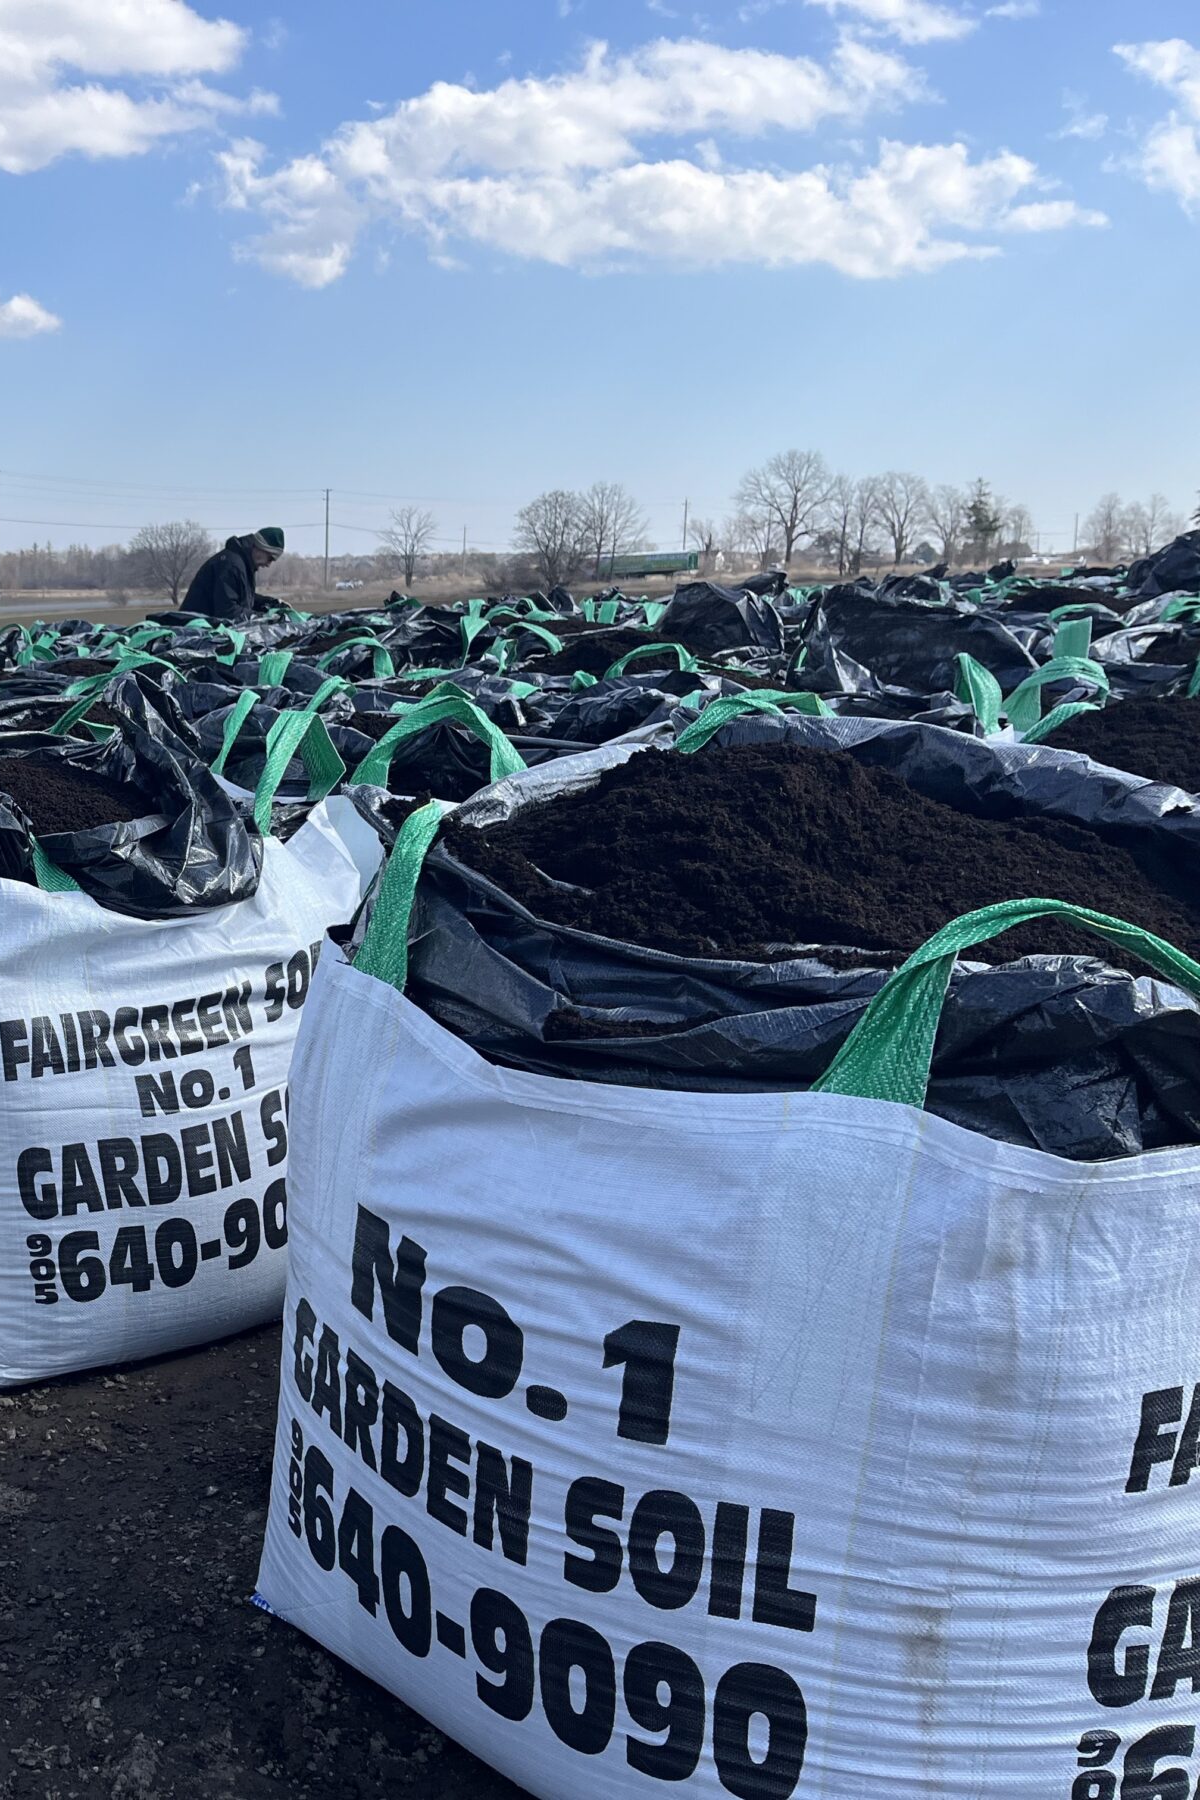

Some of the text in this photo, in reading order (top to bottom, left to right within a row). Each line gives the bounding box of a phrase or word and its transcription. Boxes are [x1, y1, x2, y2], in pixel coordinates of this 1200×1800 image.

[233, 1044, 256, 1091] 1
[16, 1110, 252, 1220] GARDEN
[26, 1233, 60, 1305] 905
[601, 1319, 681, 1446] 1
[293, 1297, 818, 1633] GARDEN SOIL
[287, 1417, 808, 1800] 905 640-9090
